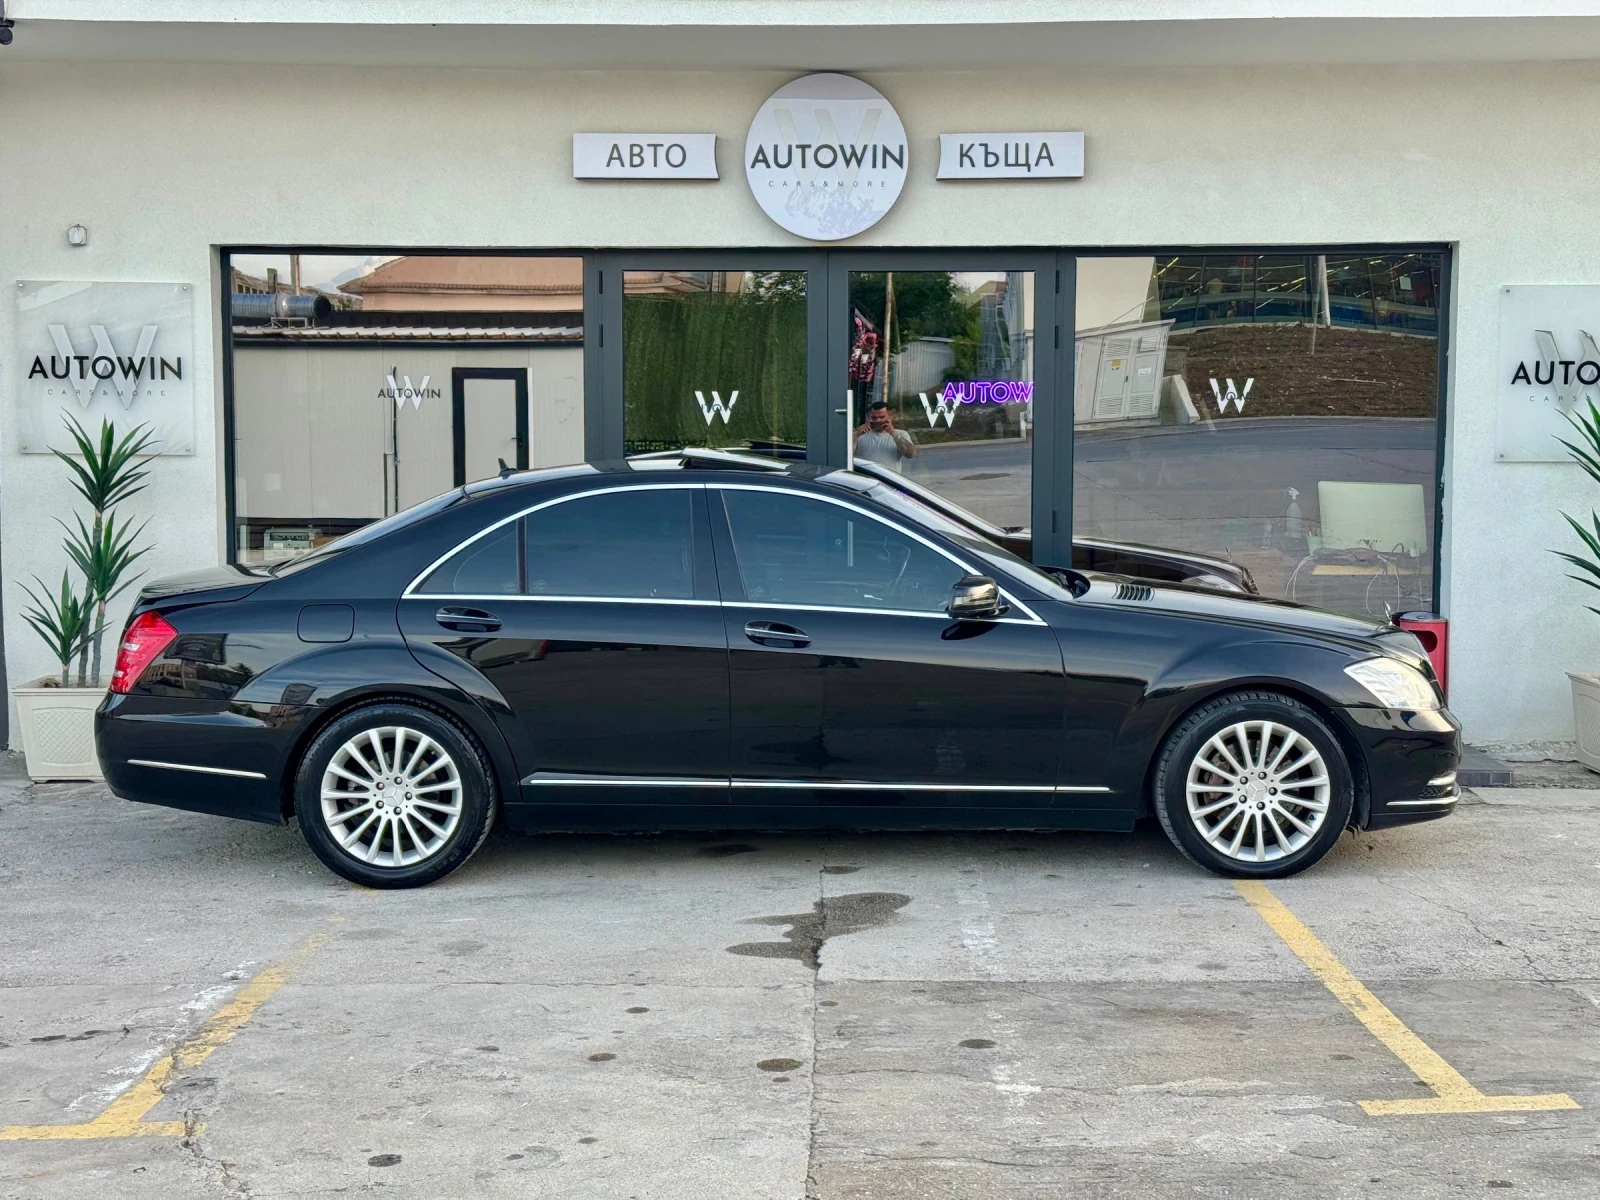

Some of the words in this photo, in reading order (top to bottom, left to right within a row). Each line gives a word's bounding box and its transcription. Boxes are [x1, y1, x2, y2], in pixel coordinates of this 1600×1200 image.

[606, 144, 687, 168] АВТО
[750, 143, 904, 169] AUTOWIN
[959, 142, 1054, 172] КЪЩА
[768, 180, 886, 188] CARS&MORE
[28, 355, 182, 380] AUTOWIN
[48, 389, 165, 397] CARS&MORE
[377, 388, 441, 398] AUTOWIN
[943, 382, 1034, 403] AUTOW
